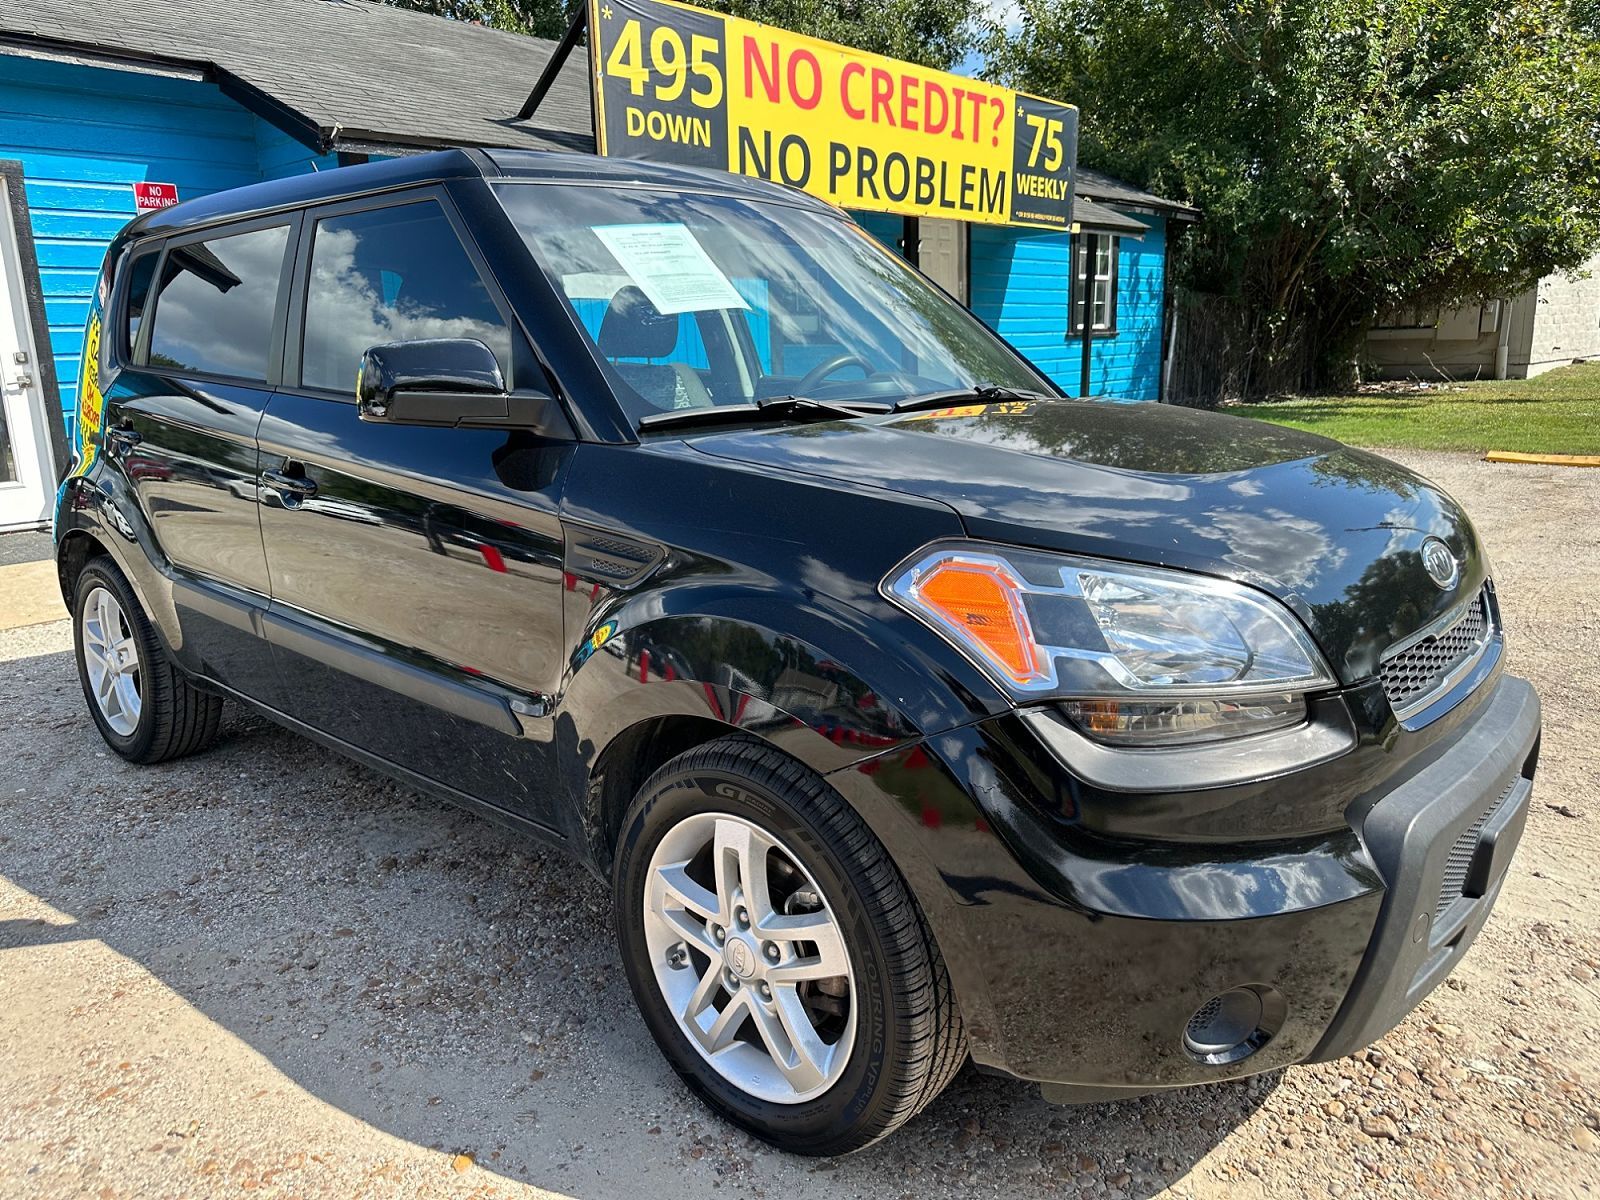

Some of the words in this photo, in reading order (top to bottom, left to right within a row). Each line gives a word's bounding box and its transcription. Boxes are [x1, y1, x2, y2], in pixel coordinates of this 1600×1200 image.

[606, 19, 723, 109] 495
[743, 35, 822, 111] NO
[840, 61, 1005, 147] CREDIT?
[626, 106, 711, 147] DOWN
[1026, 113, 1063, 172] 75
[149, 186, 162, 197] NO
[738, 125, 811, 189] NO
[829, 141, 1006, 215] PROBLEM
[1016, 172, 1068, 201] WEEKLY
[138, 196, 176, 207] PARKING
[862, 949, 883, 1054] TOURING
